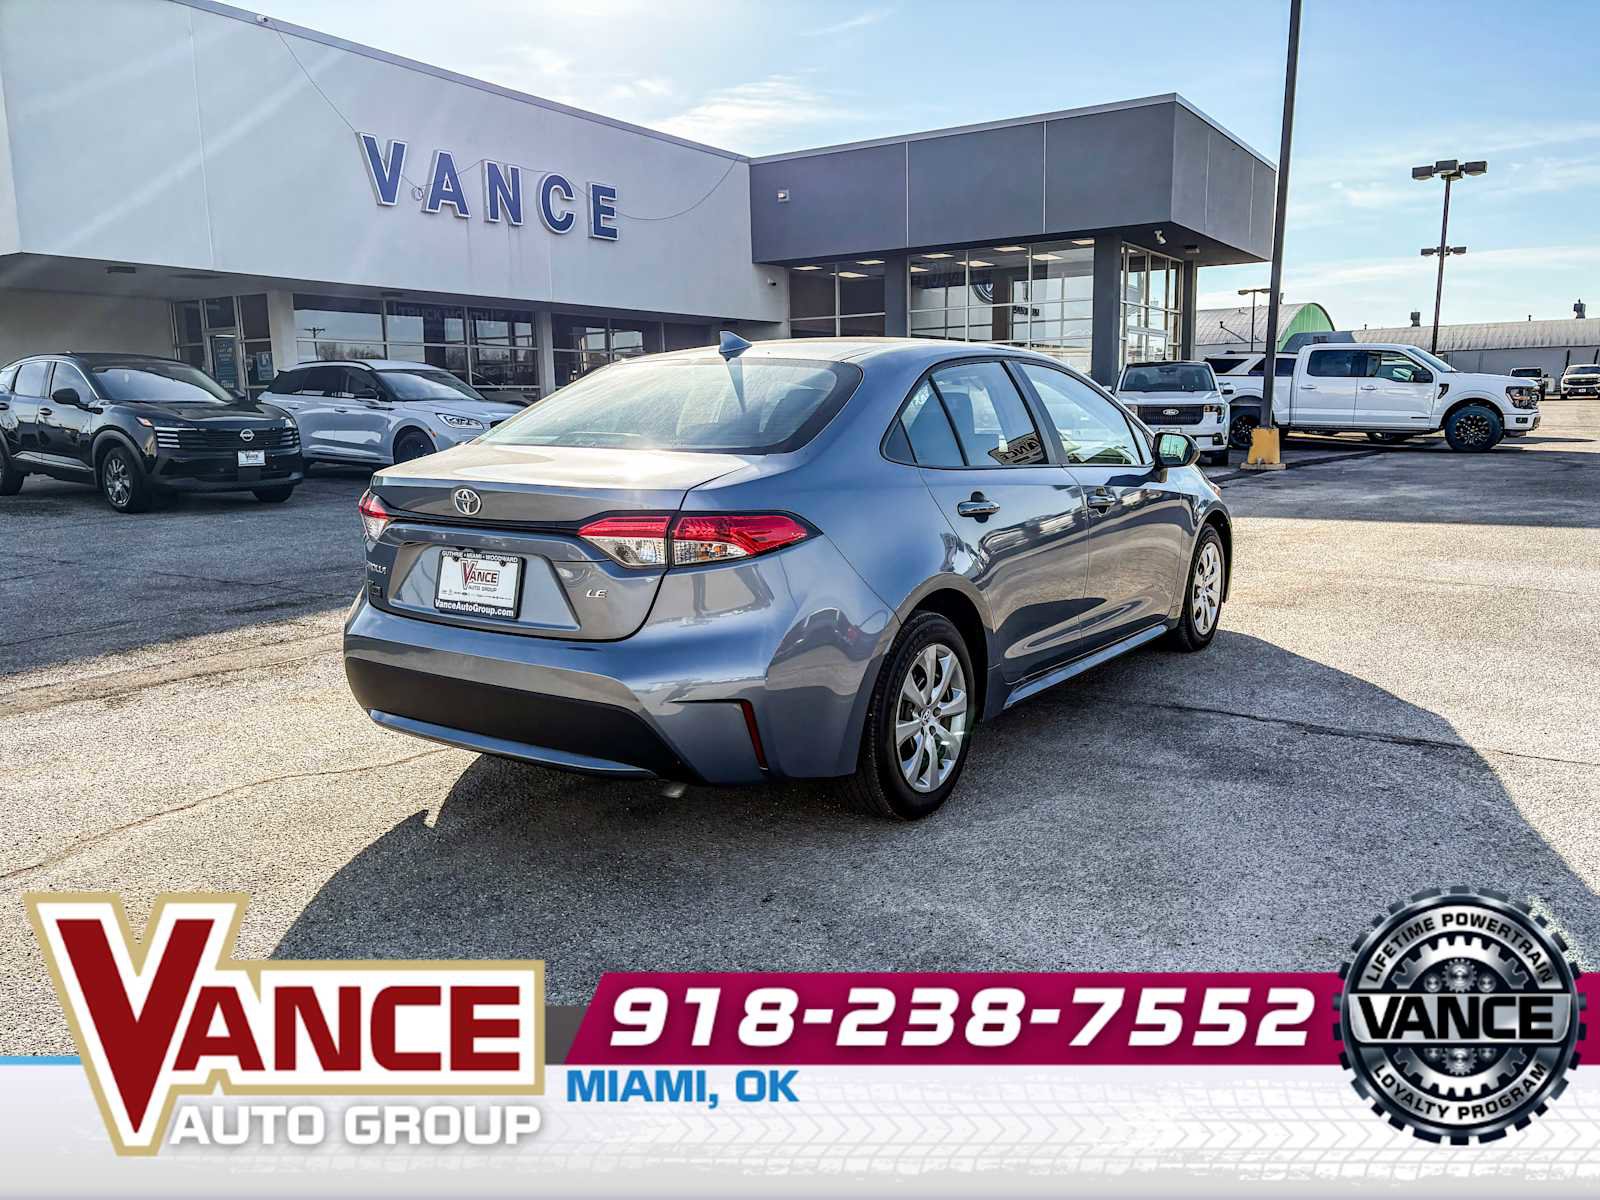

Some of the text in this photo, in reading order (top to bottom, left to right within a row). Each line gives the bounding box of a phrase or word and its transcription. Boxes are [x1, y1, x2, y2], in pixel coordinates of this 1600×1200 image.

[356, 131, 620, 241] VANCE
[462, 561, 497, 587] VANCE
[586, 589, 608, 598] LE
[435, 599, 513, 616] VanceAutoGroup.com
